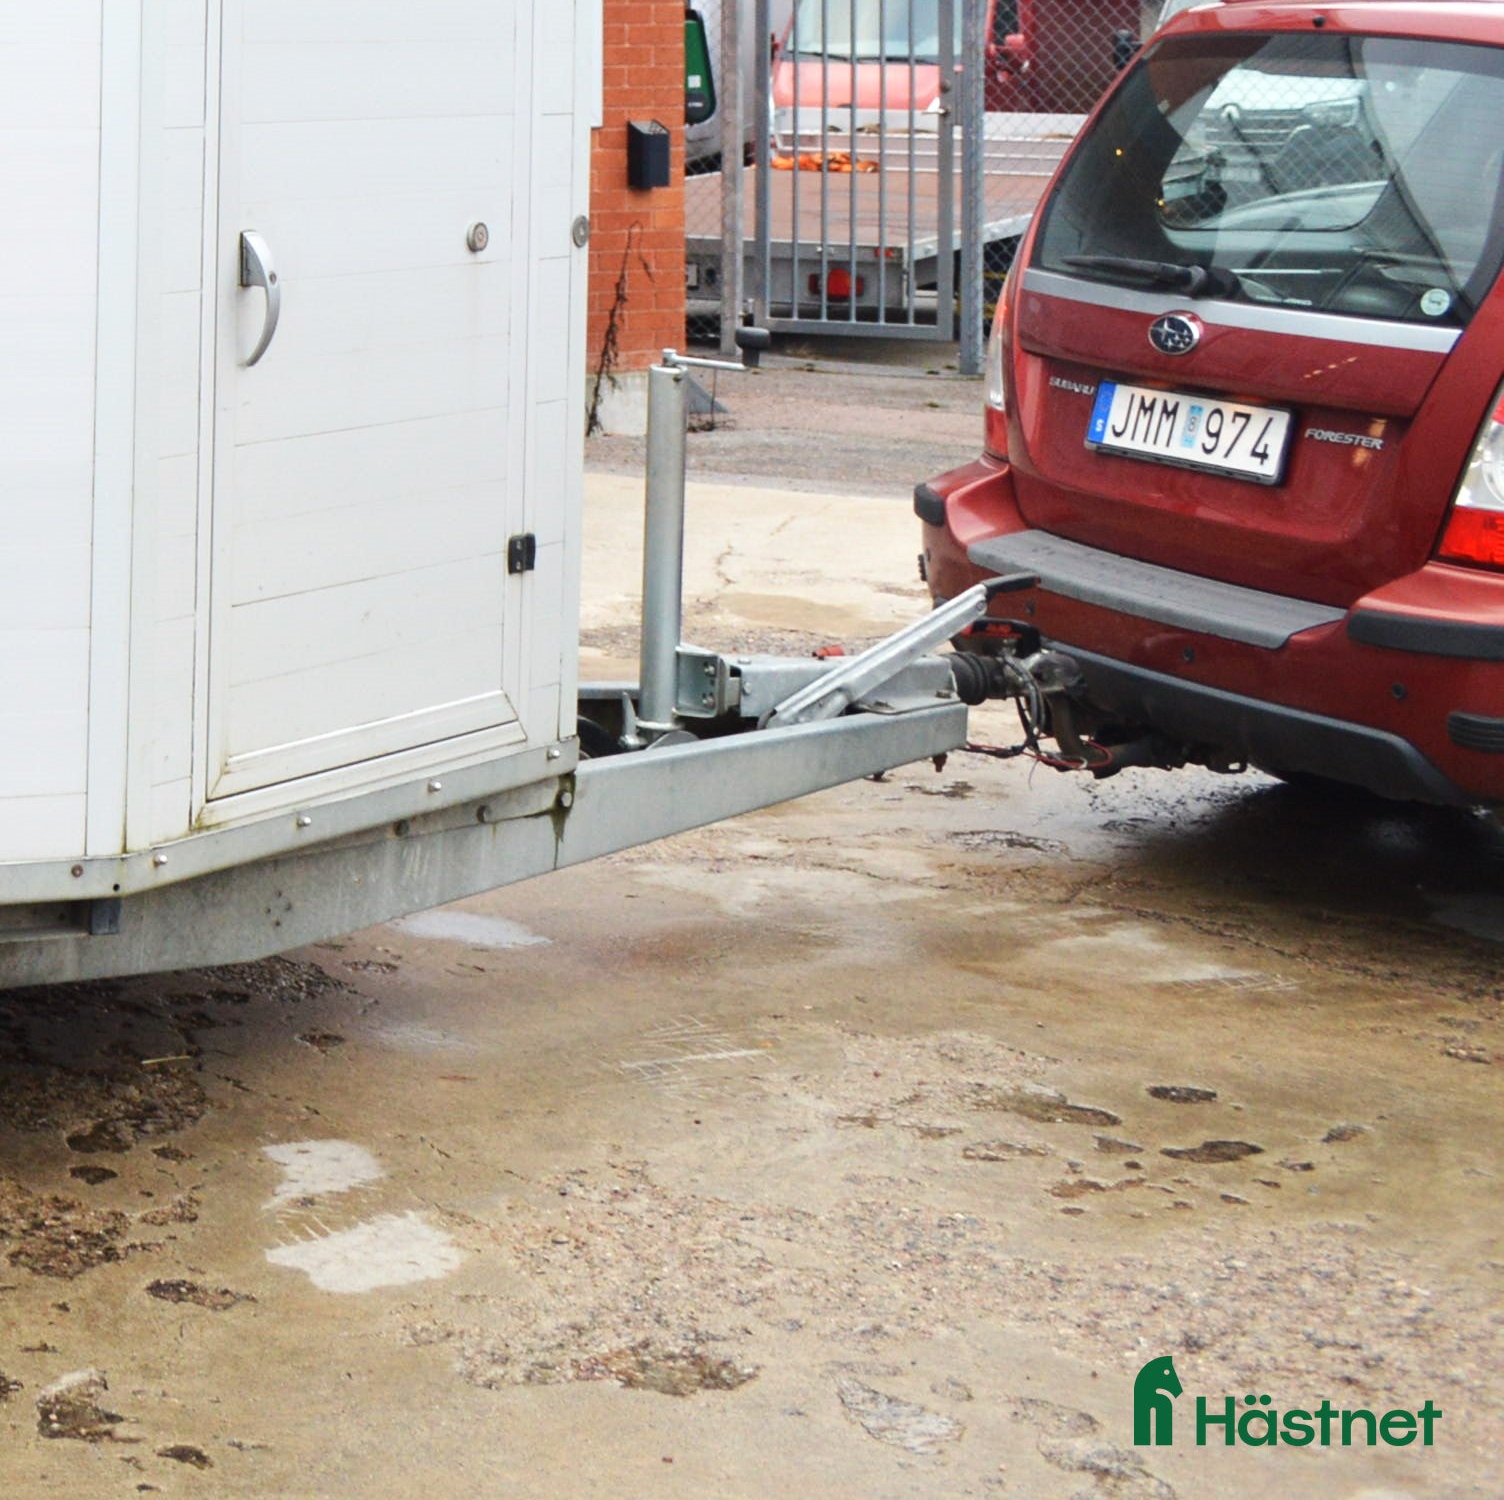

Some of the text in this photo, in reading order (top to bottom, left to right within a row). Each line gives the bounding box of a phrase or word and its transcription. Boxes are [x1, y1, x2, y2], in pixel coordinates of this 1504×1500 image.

[1111, 393, 1274, 466] JMM 974
[1304, 428, 1383, 450] FORESTER
